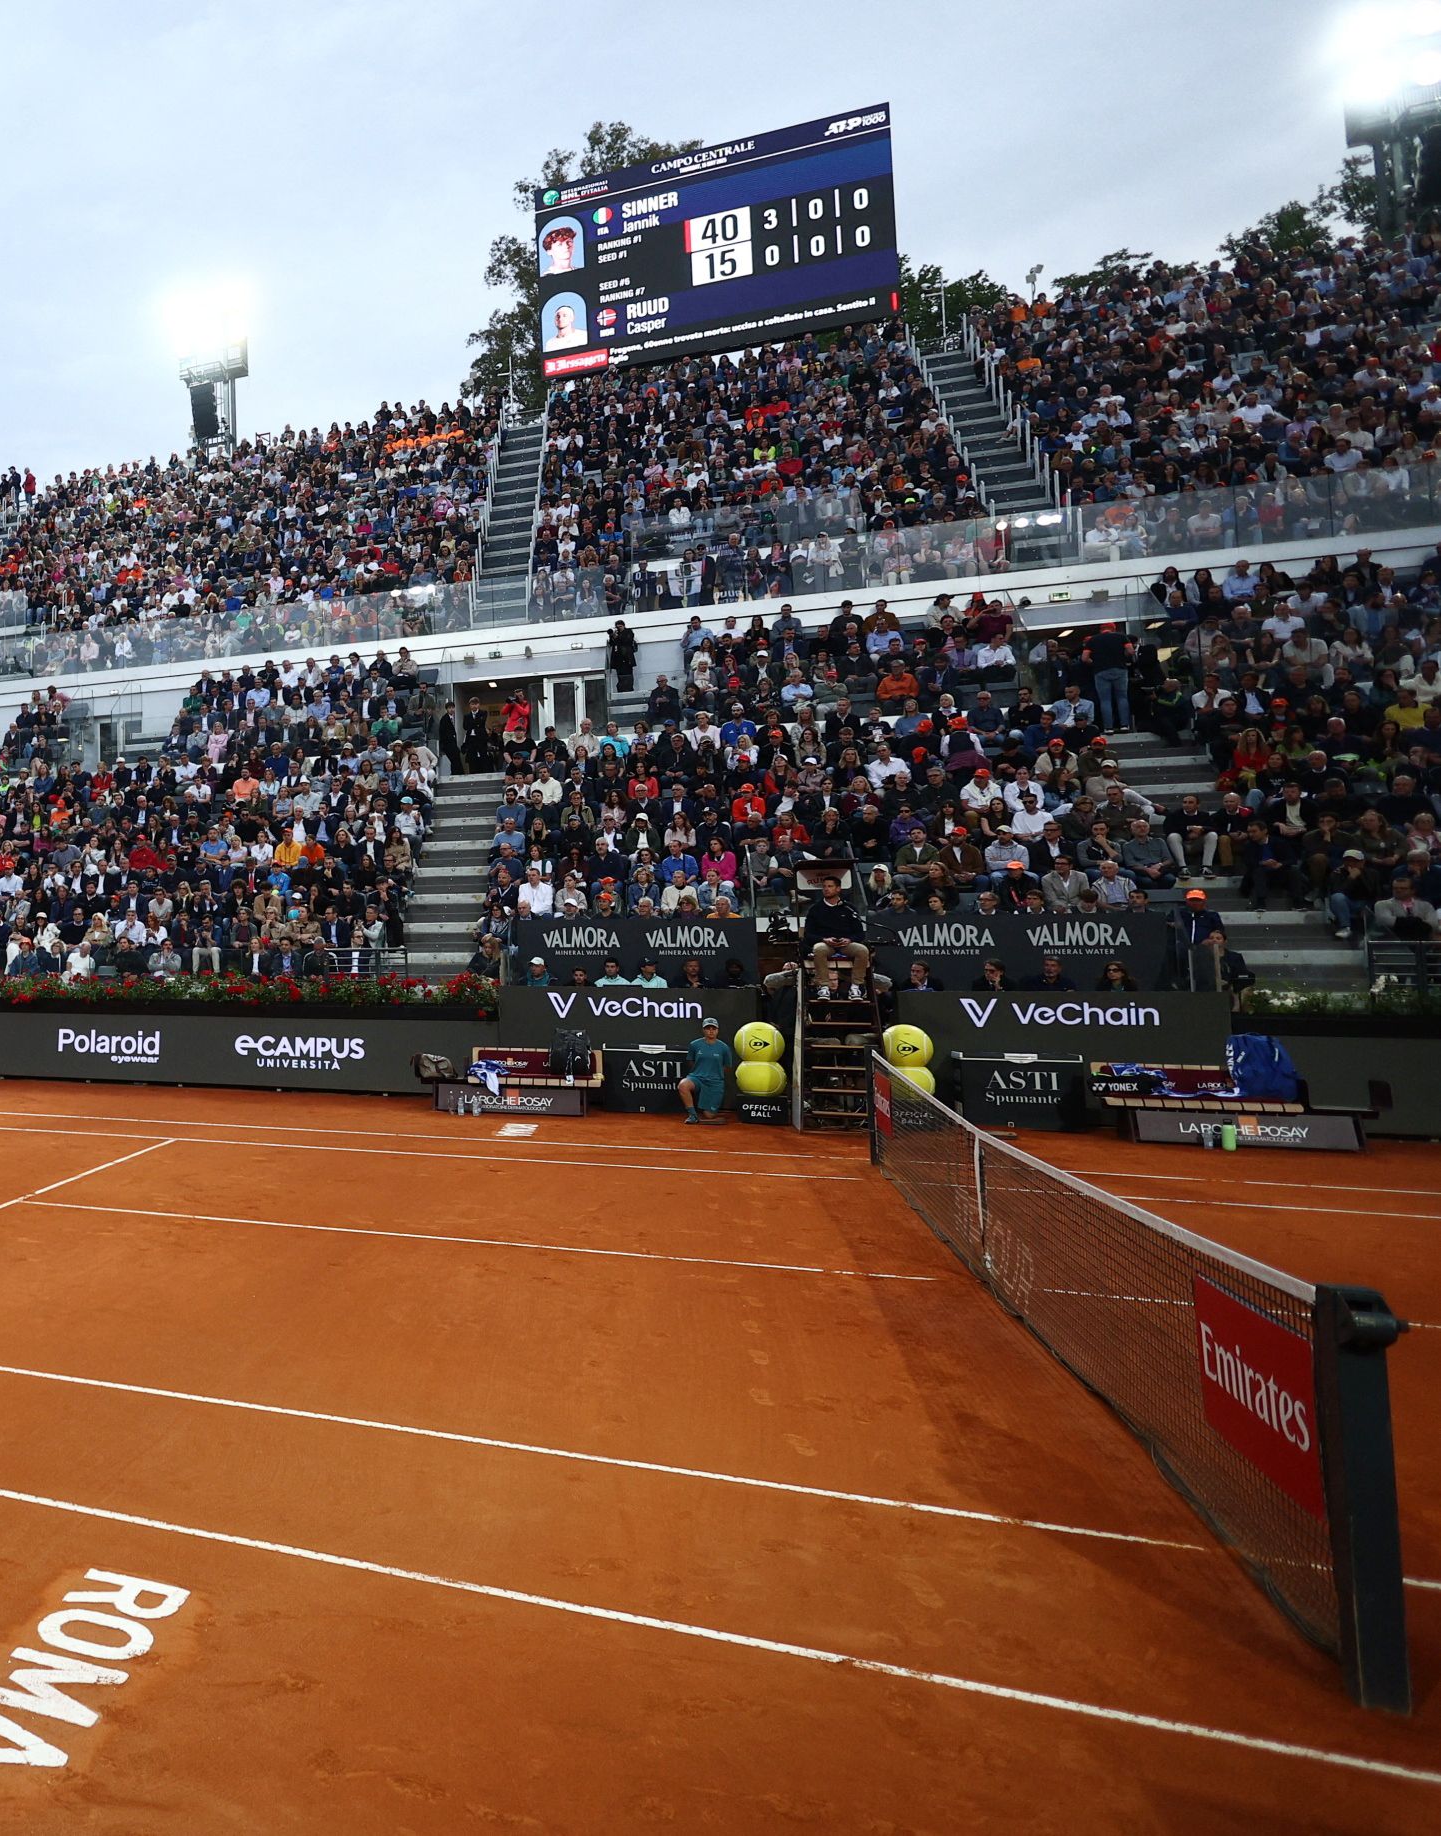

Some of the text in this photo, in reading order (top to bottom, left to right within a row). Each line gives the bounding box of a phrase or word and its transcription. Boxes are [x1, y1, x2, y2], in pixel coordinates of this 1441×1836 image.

[824, 117, 862, 136] ATP
[862, 115, 886, 126] 1000
[651, 156, 693, 174] CAMPO
[694, 140, 755, 163] CENTRALE
[561, 185, 608, 200] BNL D'ITALIA
[621, 191, 679, 219] SINNER
[622, 214, 660, 234] Jannik
[701, 188, 869, 245] 40 3 0 0
[597, 227, 610, 236] ITA
[597, 234, 642, 252] RANKING #1
[704, 225, 871, 280] 15 0 0 0
[597, 250, 628, 264] SEED #1
[599, 280, 618, 291] SEED
[599, 287, 645, 303] RANKING #7
[626, 296, 670, 320] RUUD
[804, 309, 813, 318] in
[814, 305, 836, 316] casa.
[837, 299, 868, 312] Sentito
[627, 317, 667, 335] Casper
[543, 926, 620, 948] VALMORA
[646, 926, 729, 948] VALMORA
[898, 923, 995, 947] VALMORA
[1026, 922, 1131, 946] VALMORA
[587, 996, 703, 1019] VeChain
[1012, 1002, 1160, 1026] VeChain
[58, 1029, 160, 1055] Polaroid
[110, 1055, 159, 1064] eyewear
[256, 1058, 341, 1070] UNIVERSITÀ
[623, 1059, 684, 1079] ASTI
[622, 1078, 679, 1092] Spumant
[985, 1070, 1060, 1091] ASTI
[1108, 1082, 1138, 1092] YONEX
[479, 1095, 516, 1106] ROCHE
[518, 1097, 553, 1107] POSAY
[742, 1104, 782, 1112] OFFICIAL
[985, 1091, 1061, 1106] Spumante
[751, 1110, 771, 1118] BALL
[1179, 1122, 1200, 1134] LA
[1200, 1123, 1256, 1136] ROHE
[1257, 1126, 1309, 1138] POSAY
[1199, 1321, 1310, 1452] Emirates
